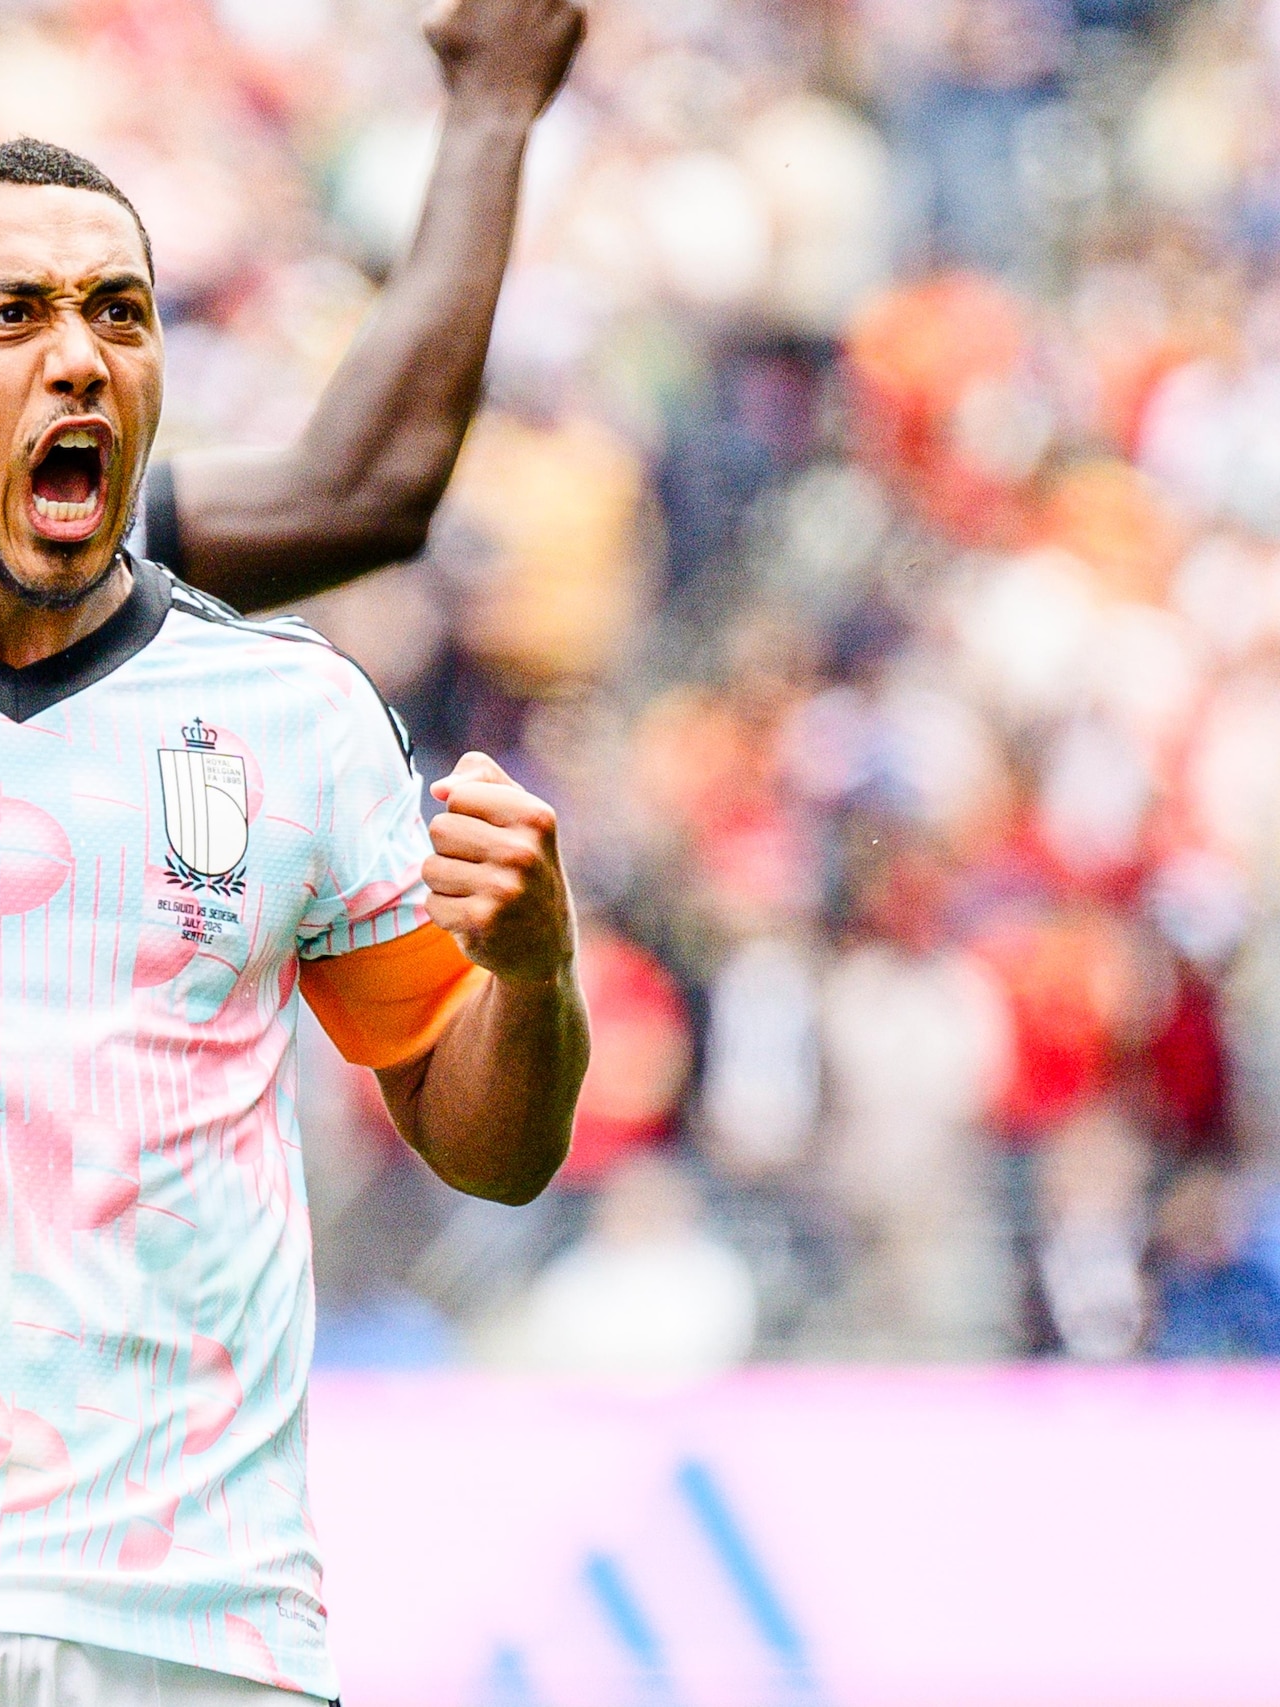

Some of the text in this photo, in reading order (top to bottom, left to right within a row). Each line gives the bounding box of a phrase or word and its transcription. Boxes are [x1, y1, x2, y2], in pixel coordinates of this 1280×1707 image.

[207, 767, 241, 776] BELGIAN
[157, 900, 195, 914] BELGIUM
[209, 908, 240, 924] SENEGAL
[182, 916, 201, 928] JULY
[181, 930, 214, 944] SEATTLE
